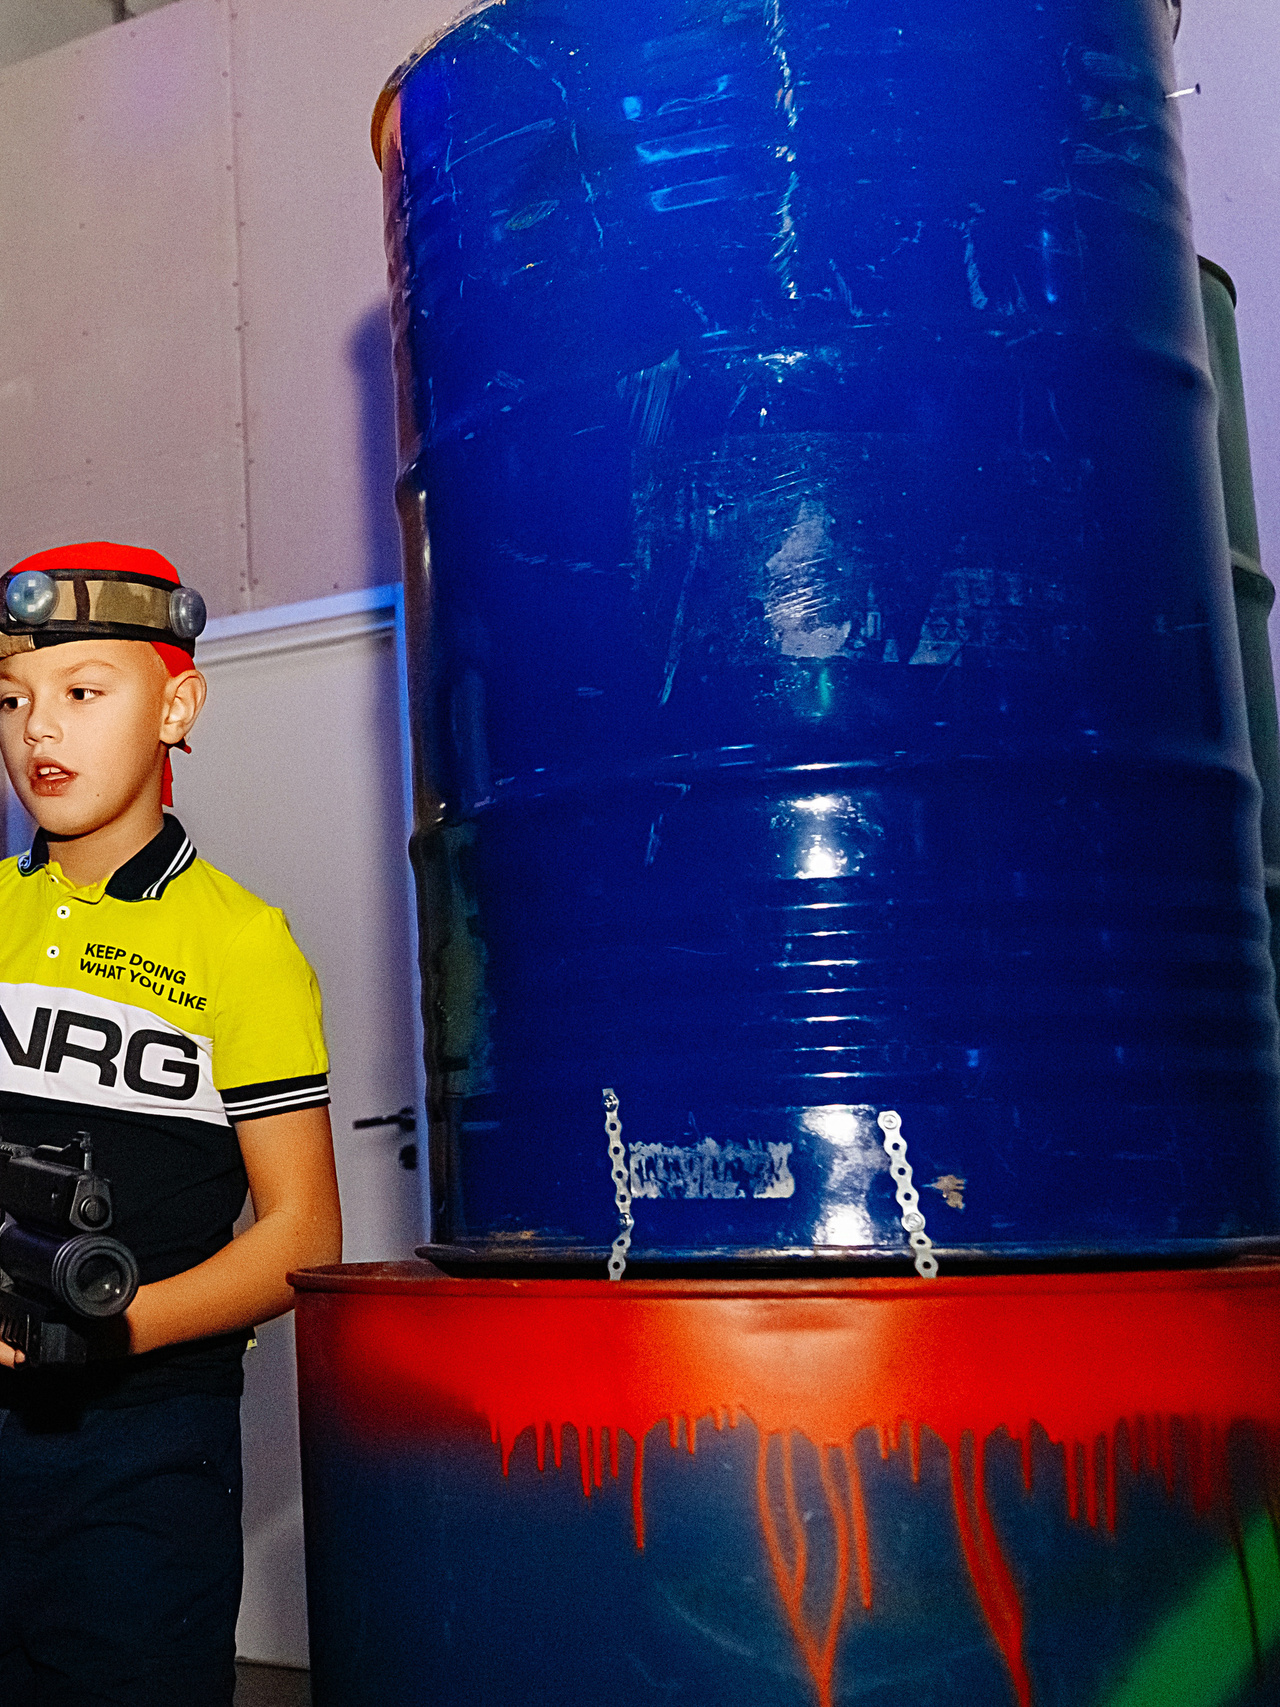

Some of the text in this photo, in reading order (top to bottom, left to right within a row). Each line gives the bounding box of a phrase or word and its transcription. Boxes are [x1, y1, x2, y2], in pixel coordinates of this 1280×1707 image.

[79, 957, 207, 1011] WHAT YOU LIKE
[84, 942, 187, 985] KEEP DOING
